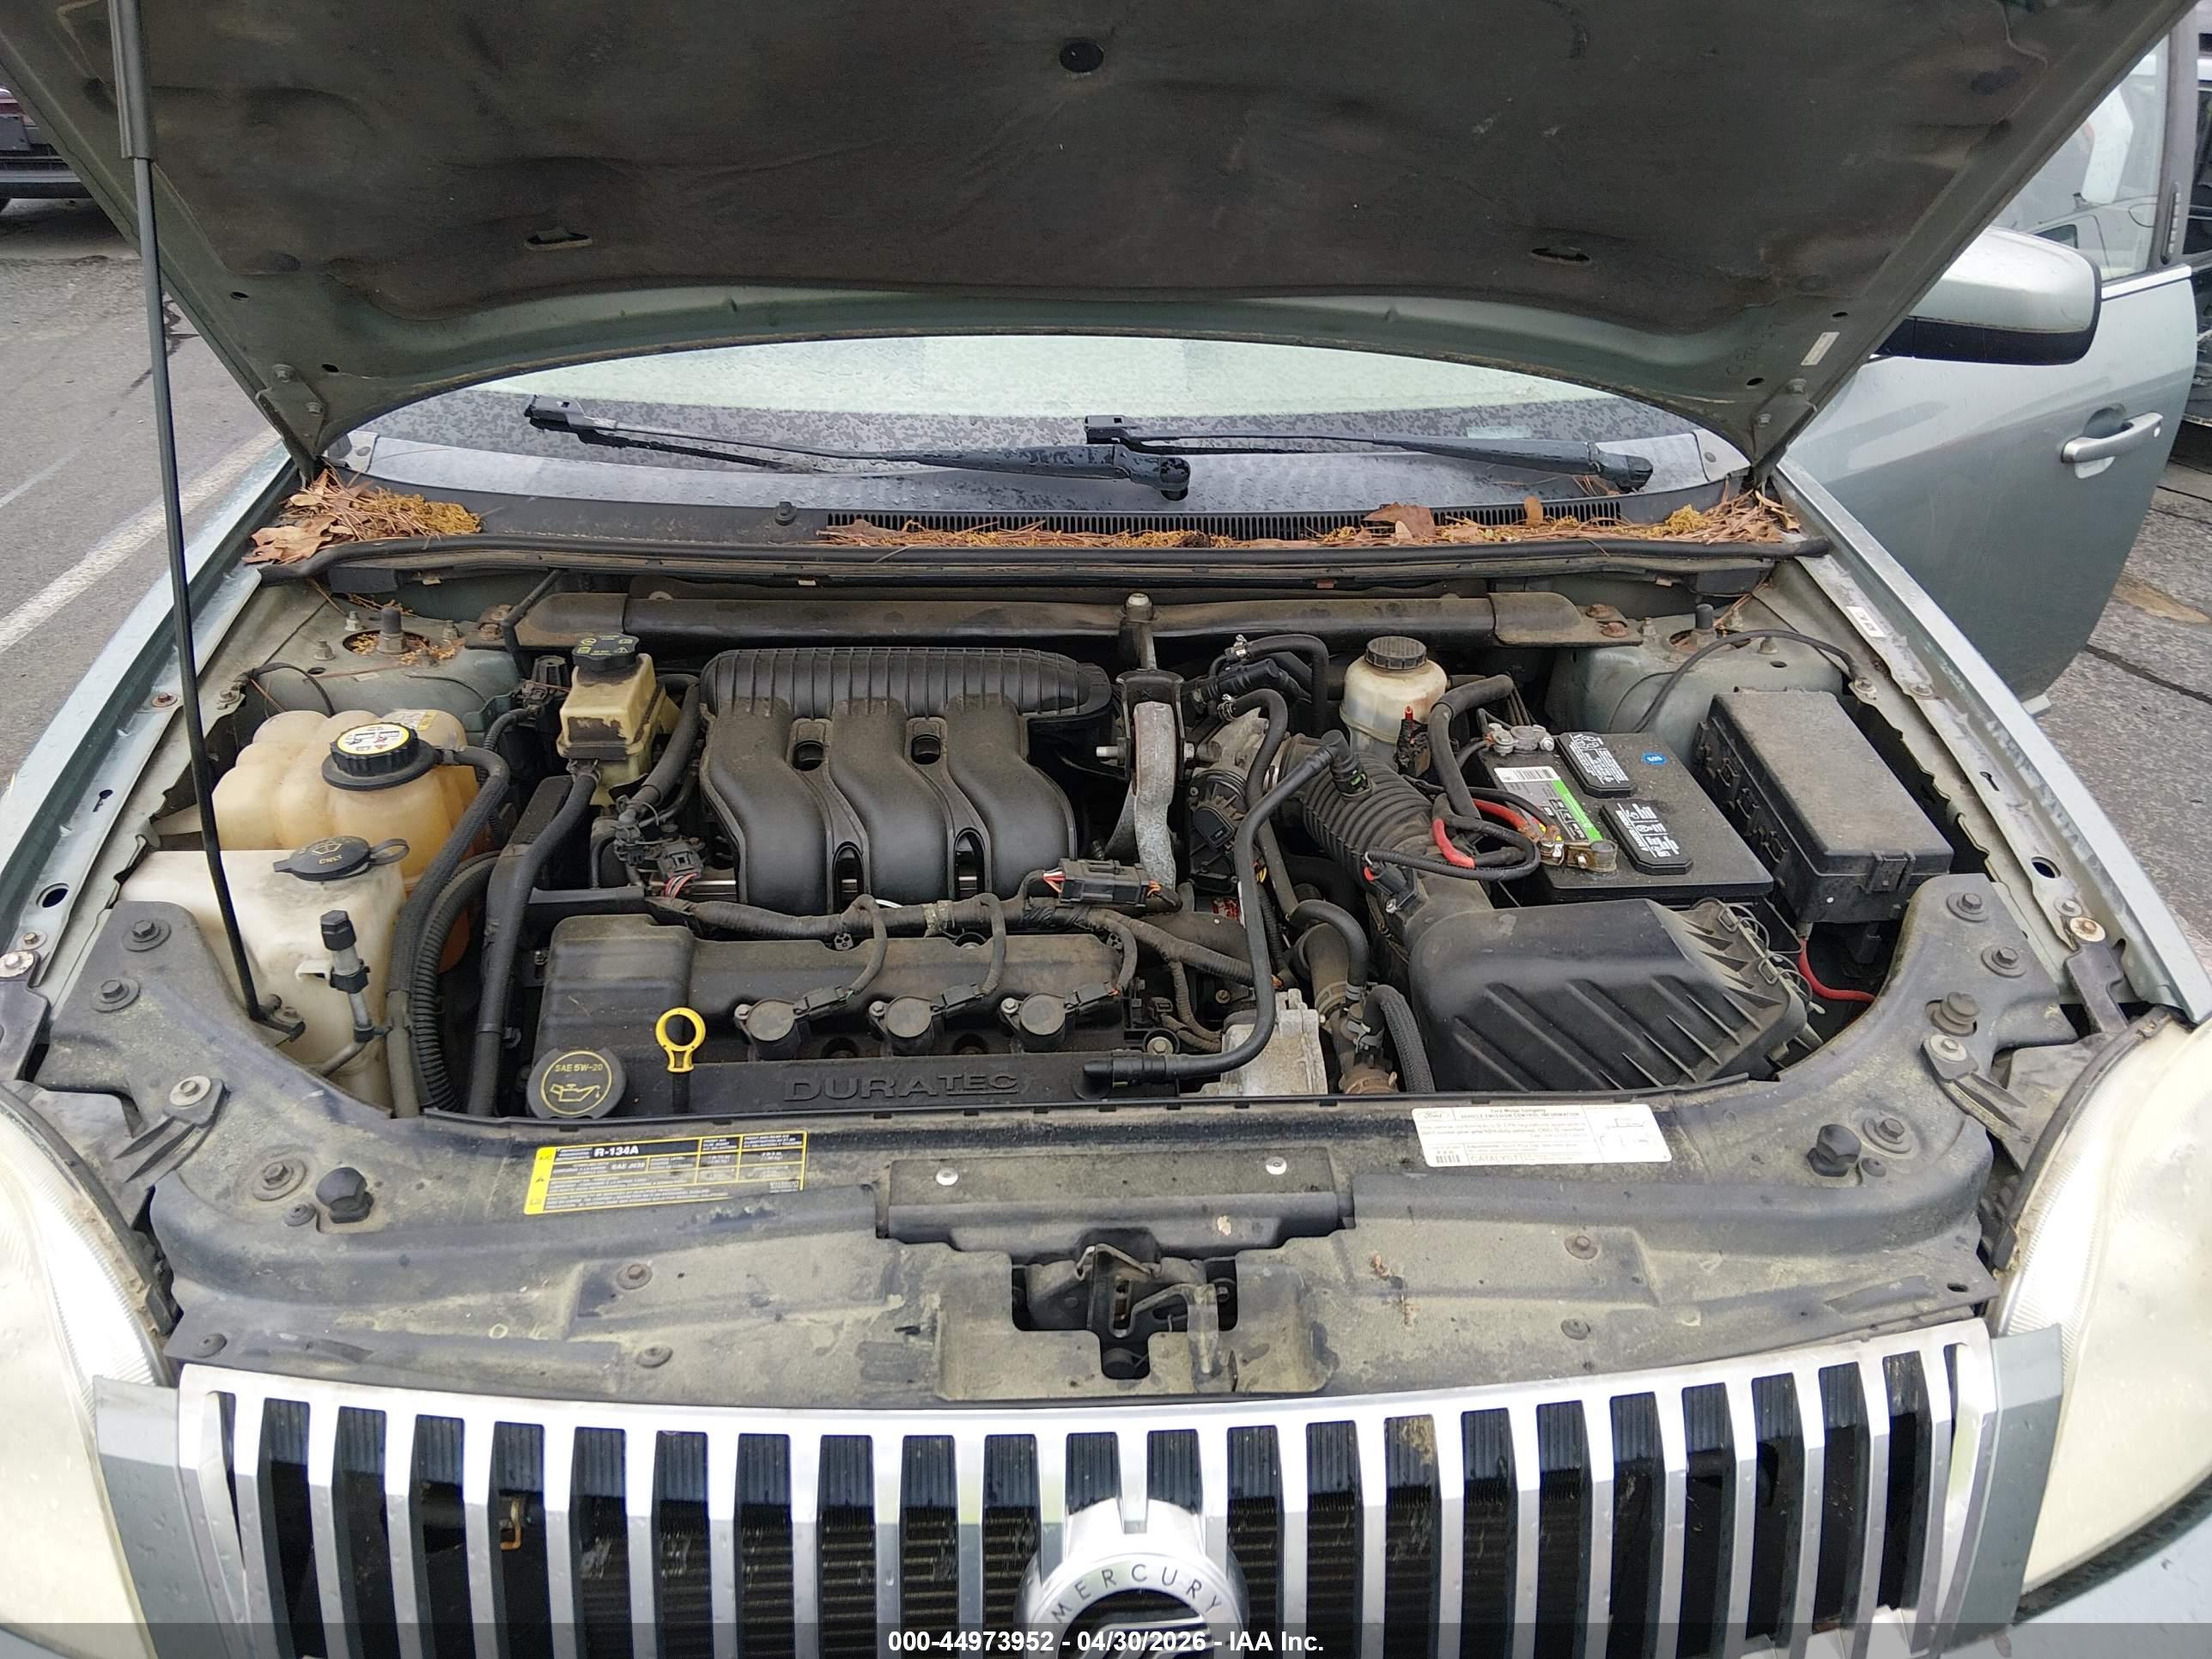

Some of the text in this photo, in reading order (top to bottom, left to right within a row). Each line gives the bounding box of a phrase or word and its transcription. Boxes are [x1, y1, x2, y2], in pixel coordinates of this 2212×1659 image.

[555, 1063, 604, 1073] SAE 5W-20
[784, 1073, 1019, 1103] DURATEC
[594, 1146, 639, 1157] R-134A
[1051, 1564, 1222, 1624] MERCURY
